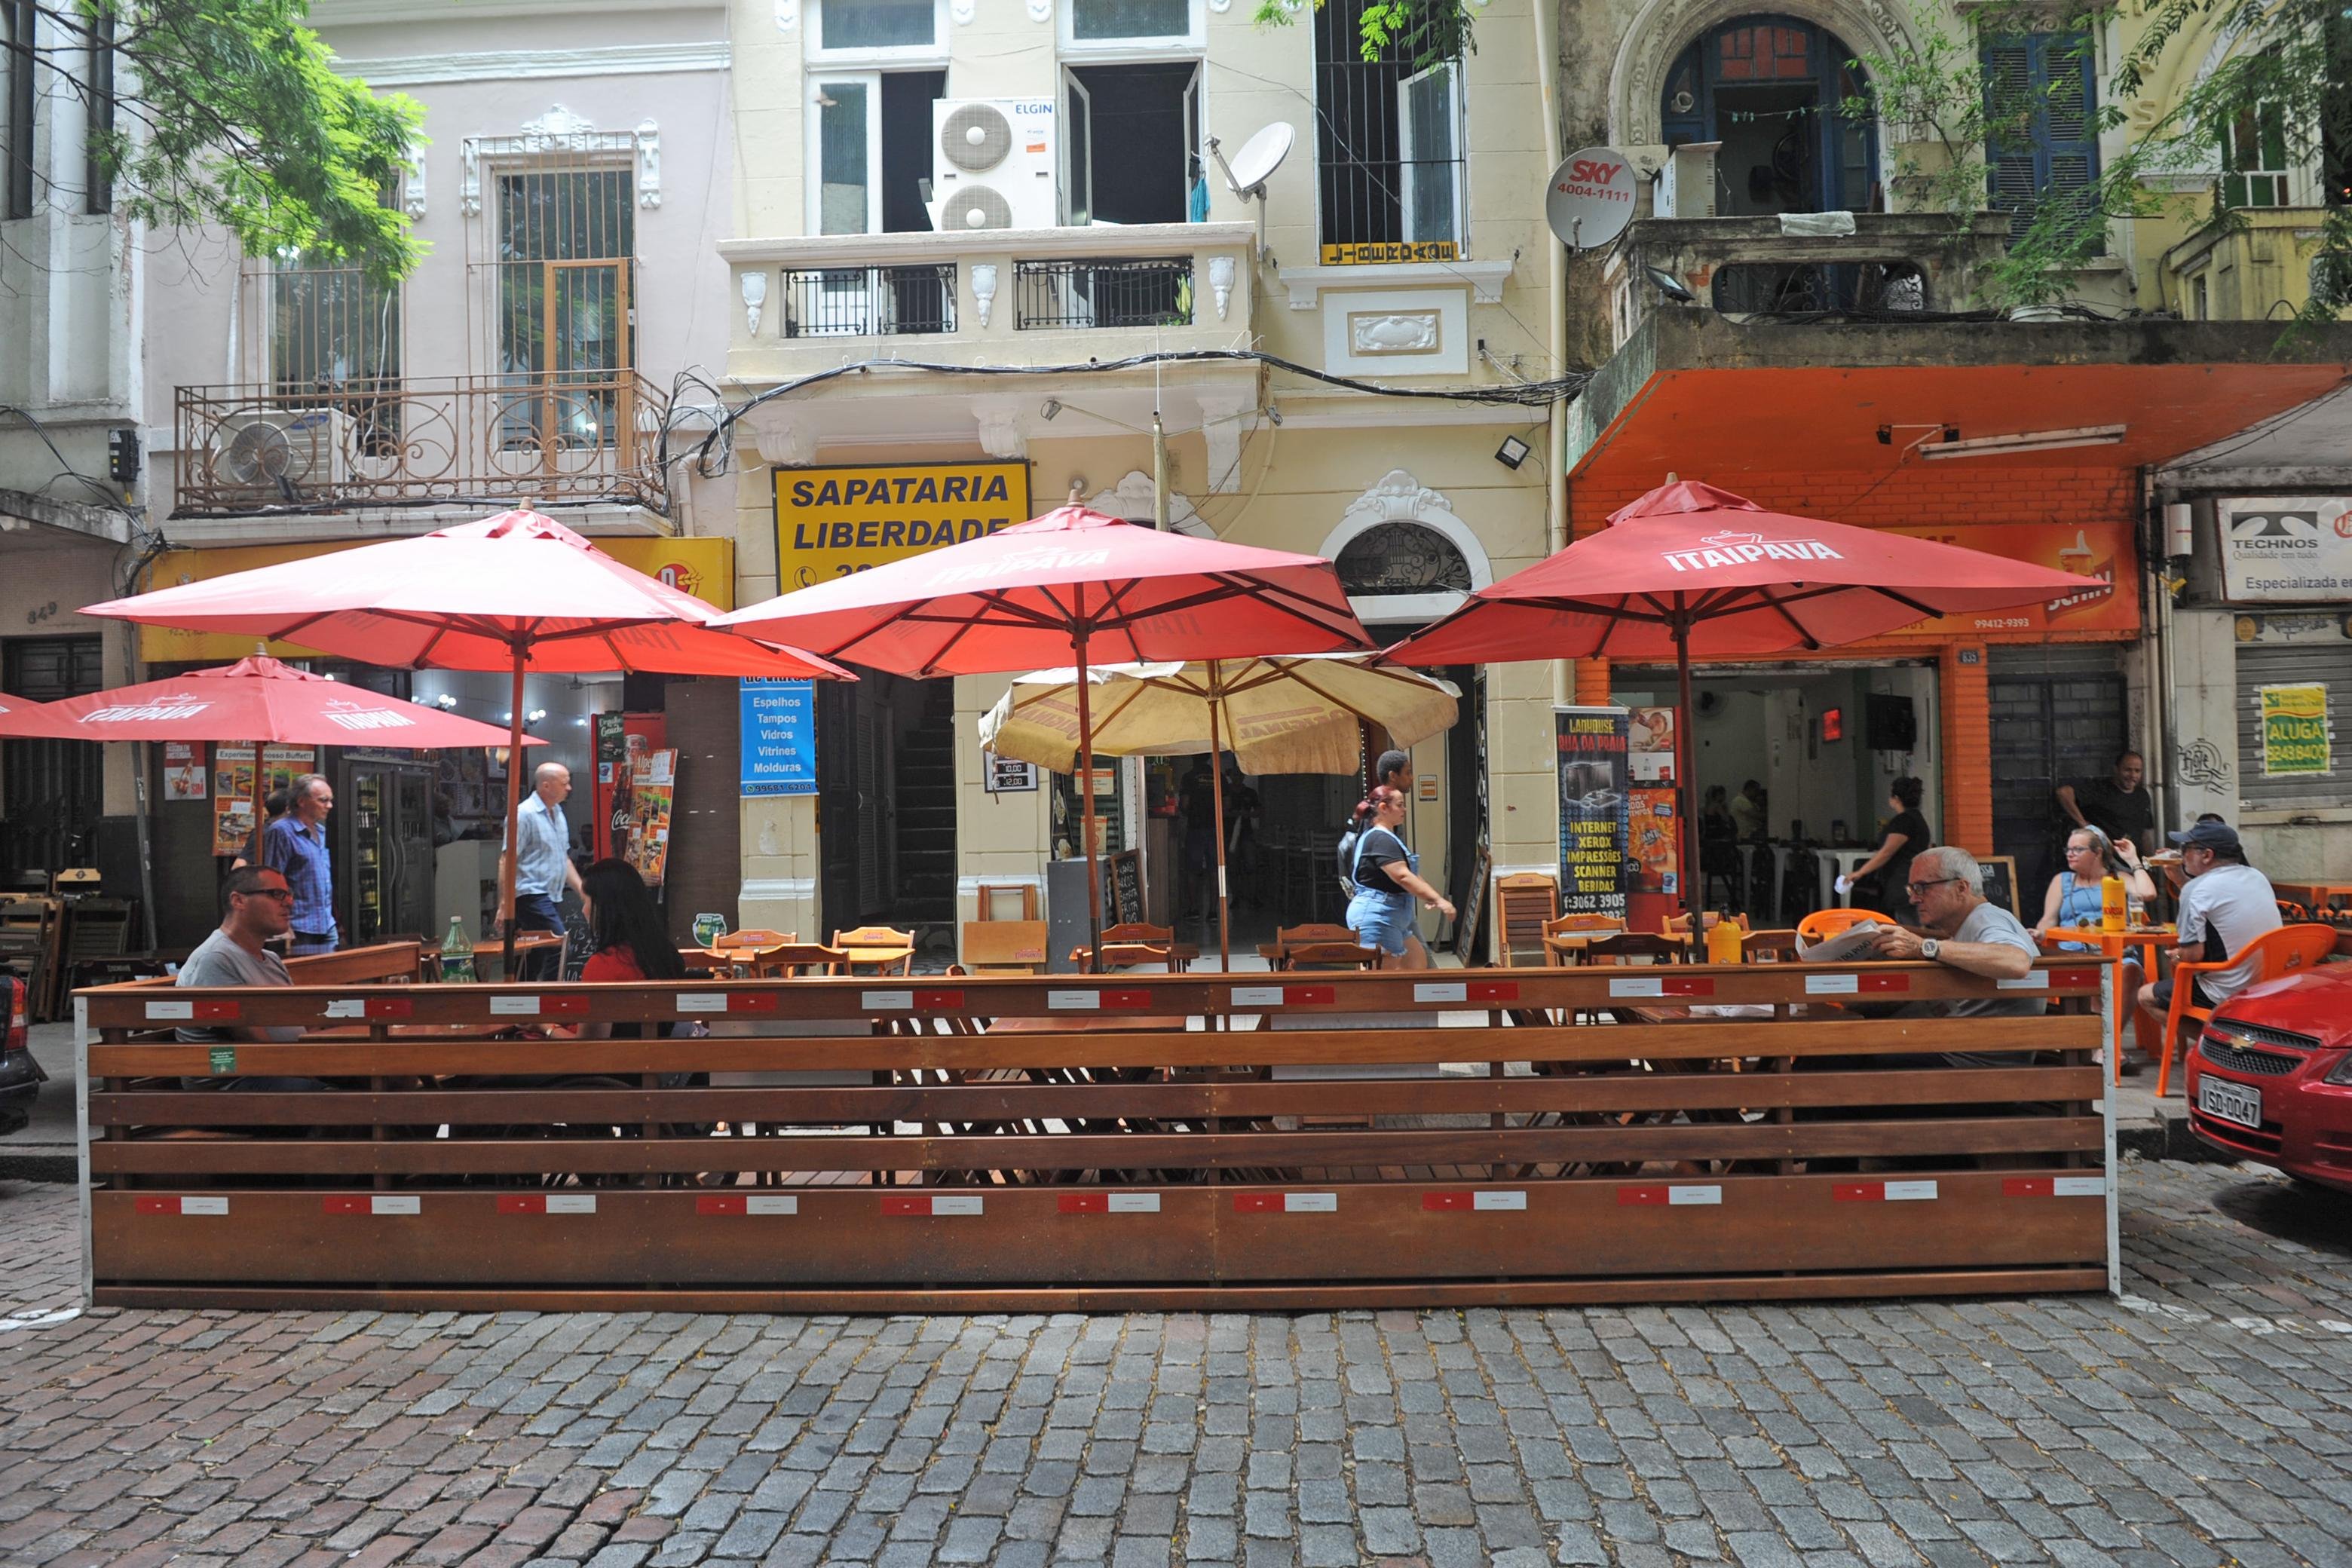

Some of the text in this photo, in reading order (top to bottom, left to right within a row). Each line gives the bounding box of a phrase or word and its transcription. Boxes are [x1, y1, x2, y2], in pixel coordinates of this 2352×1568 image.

[1015, 104, 1052, 114] ELGIN
[1569, 159, 1622, 185] SKY
[1557, 182, 1629, 202] 4004-1111
[791, 475, 1009, 507] SAPATARIA
[2233, 539, 2319, 550] TECHNOS
[1664, 541, 1845, 572] ITAIPAVA
[2233, 550, 2279, 562] Qualidade
[2246, 577, 2338, 592] Especializada
[1974, 618, 2029, 629] 99412-9393
[753, 697, 801, 709] Espelhos
[757, 713, 798, 724] Tampos
[761, 729, 794, 740] Vidros
[2269, 721, 2324, 740] ALUGA
[1558, 735, 1627, 752] RUA DA PRAIA
[758, 746, 797, 757] Vitrines
[754, 762, 801, 773] Molduras
[1006, 764, 1021, 773] 10,00
[1006, 778, 1022, 786] 12,00
[1570, 822, 1617, 834] INTERNET
[1579, 836, 1612, 848] XEROX
[1567, 850, 1622, 862] IMPRESSÕES
[1574, 865, 1616, 877] SCANNER
[1578, 880, 1615, 892] BEBIDAS
[1564, 893, 1625, 909] f:3062 3905
